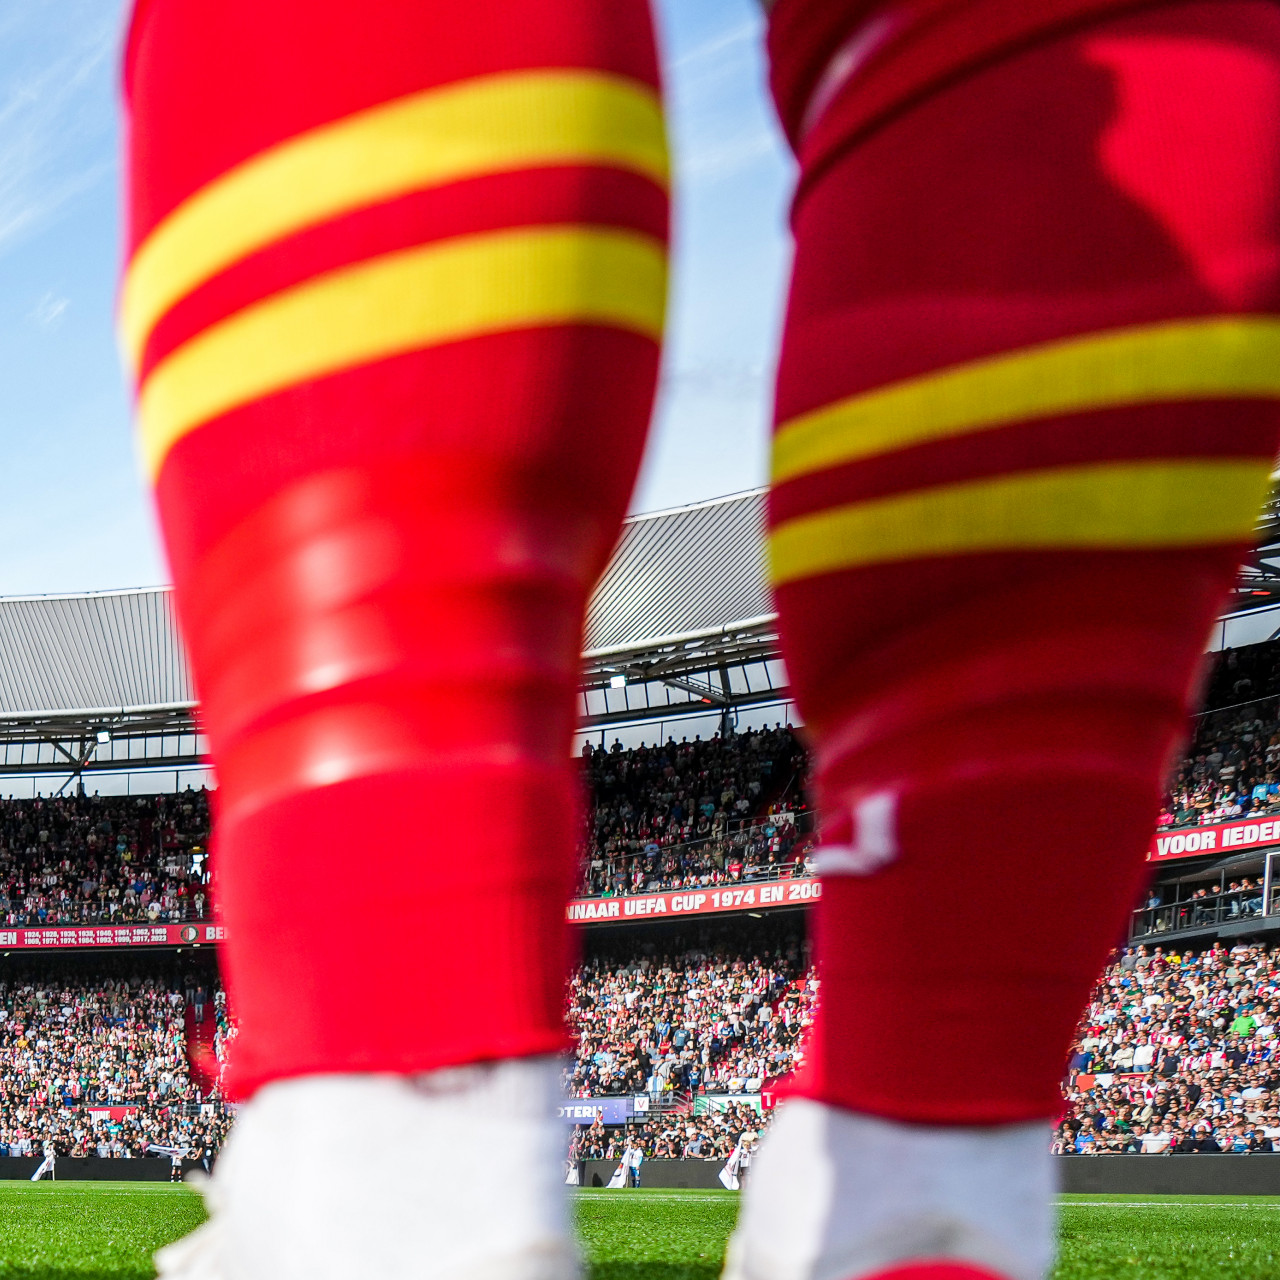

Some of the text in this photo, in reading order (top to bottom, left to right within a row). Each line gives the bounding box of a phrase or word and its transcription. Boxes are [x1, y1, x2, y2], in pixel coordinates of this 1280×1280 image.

[1157, 830, 1217, 856] VOOR
[624, 897, 667, 916] UEFA
[671, 893, 707, 913] CUP
[711, 889, 756, 907] 1974
[760, 885, 784, 903] EN
[42, 938, 59, 946] 1971,
[60, 938, 77, 946] 1974,
[132, 936, 150, 944] 2017,
